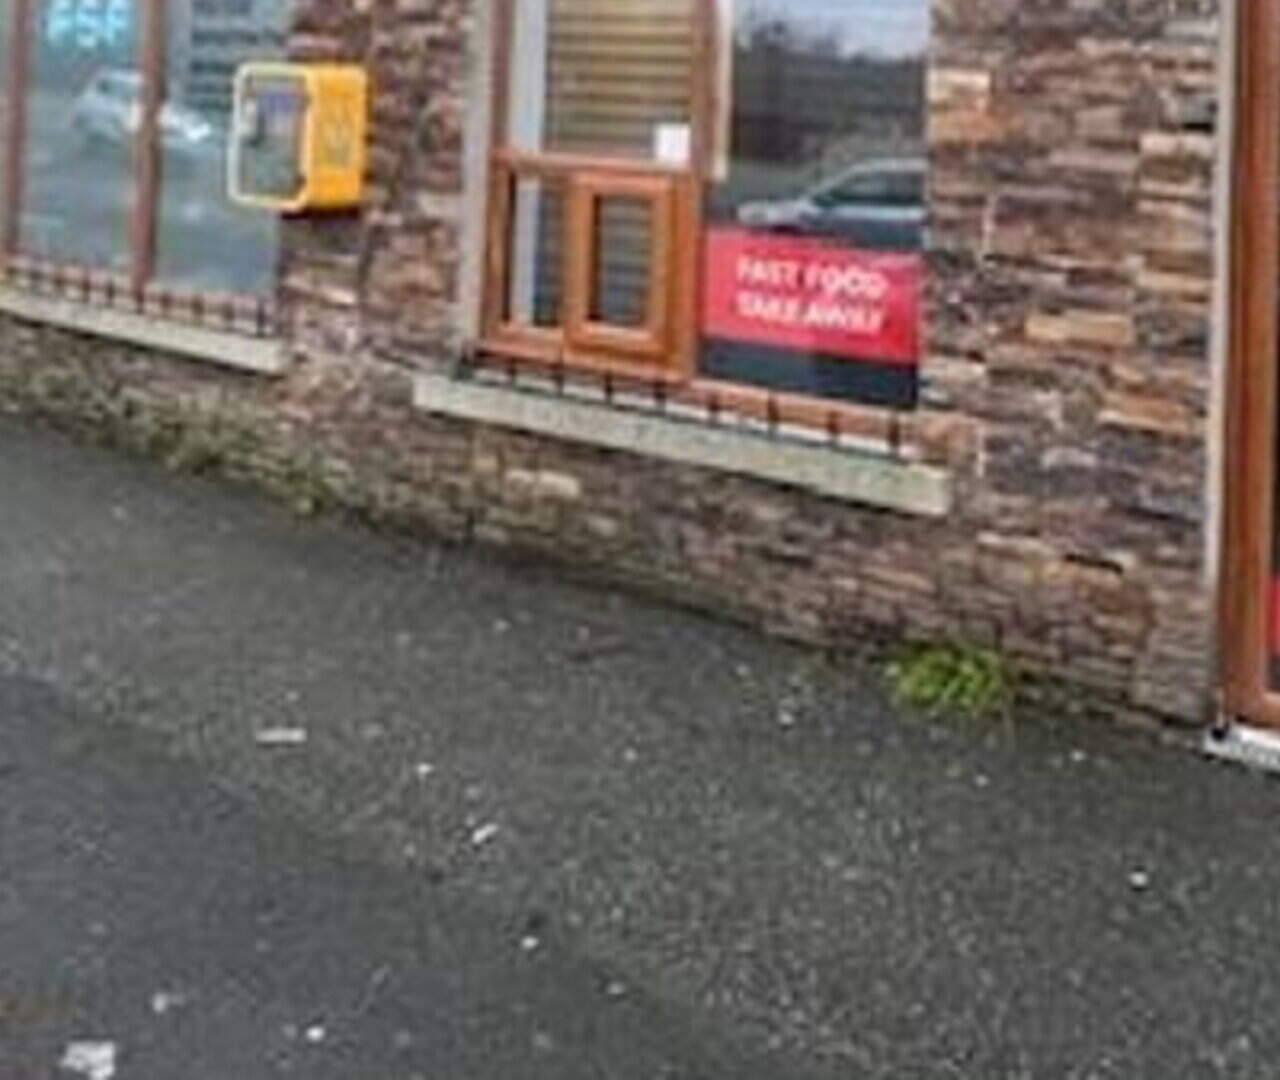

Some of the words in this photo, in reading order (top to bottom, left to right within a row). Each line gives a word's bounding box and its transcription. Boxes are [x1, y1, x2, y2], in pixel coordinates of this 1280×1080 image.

[736, 255, 800, 289] FAST
[806, 263, 889, 299] FOOD
[736, 292, 805, 323] TAKE
[806, 300, 885, 335] AWAY
